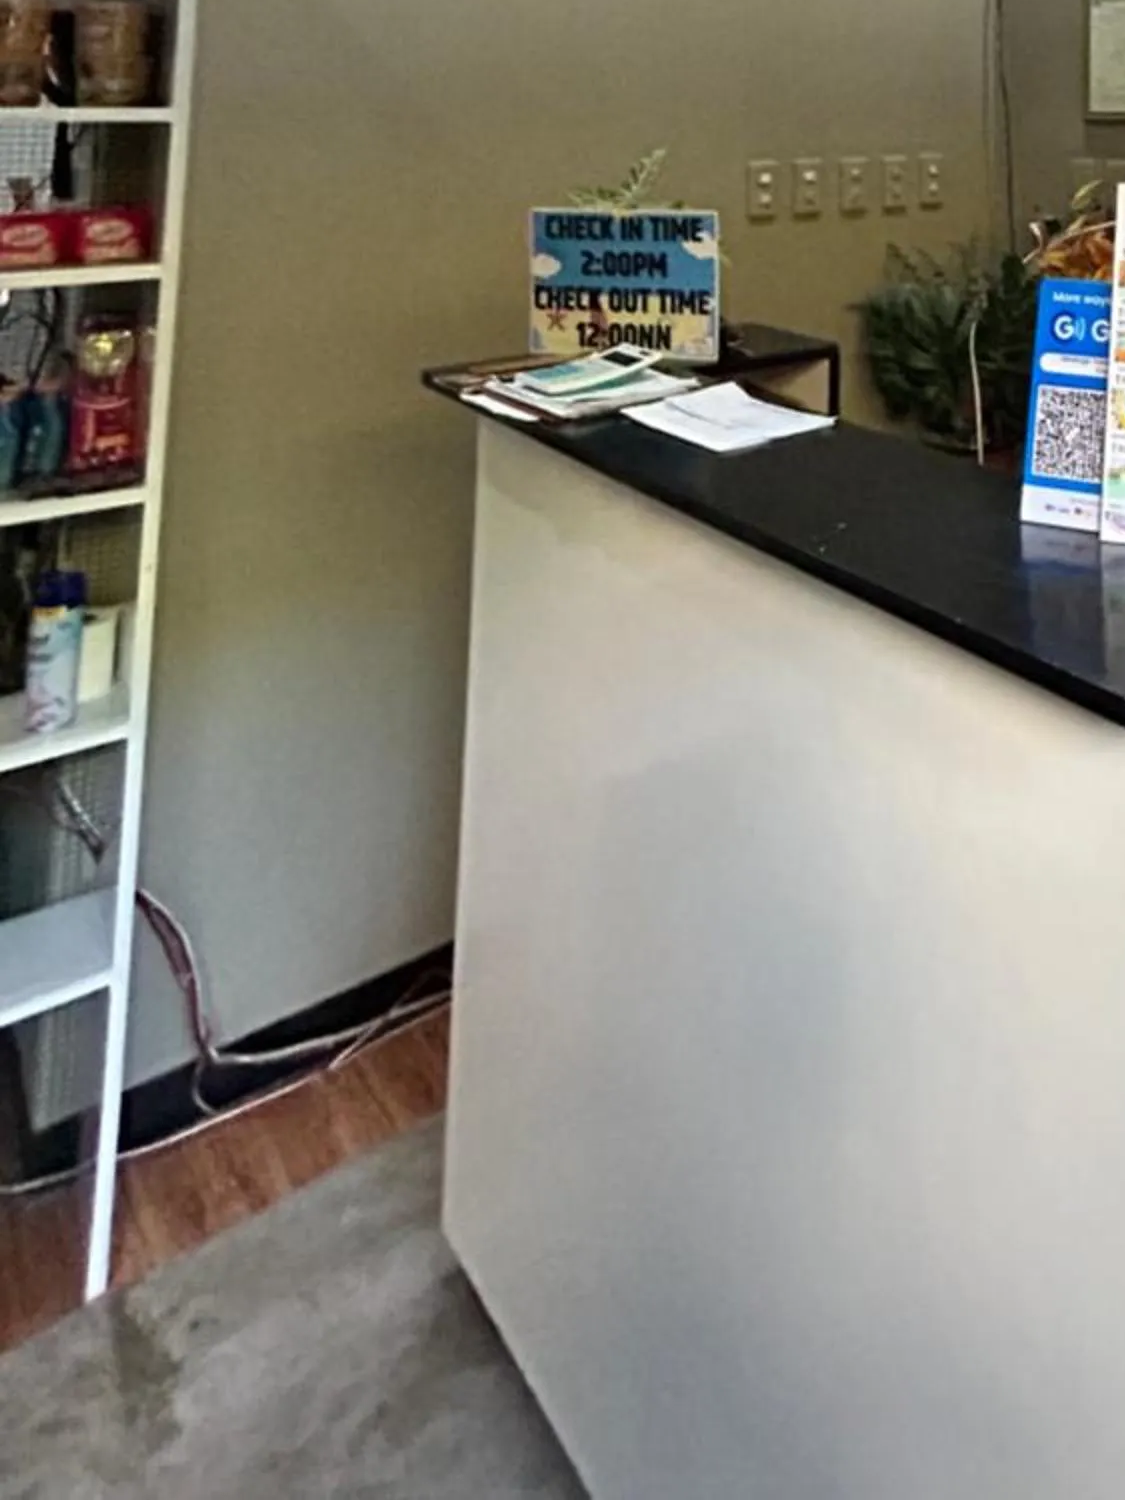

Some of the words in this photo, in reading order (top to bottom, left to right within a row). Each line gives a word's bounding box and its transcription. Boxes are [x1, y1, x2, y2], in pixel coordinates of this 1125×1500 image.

[544, 215, 614, 241] CHECK
[620, 215, 644, 241] IN
[651, 216, 704, 242] TIME
[580, 250, 668, 279] 2:00PM
[533, 285, 604, 313] CHECK
[608, 286, 650, 314] OUT
[658, 288, 712, 316] TIME
[576, 322, 672, 351] 12:00NN
